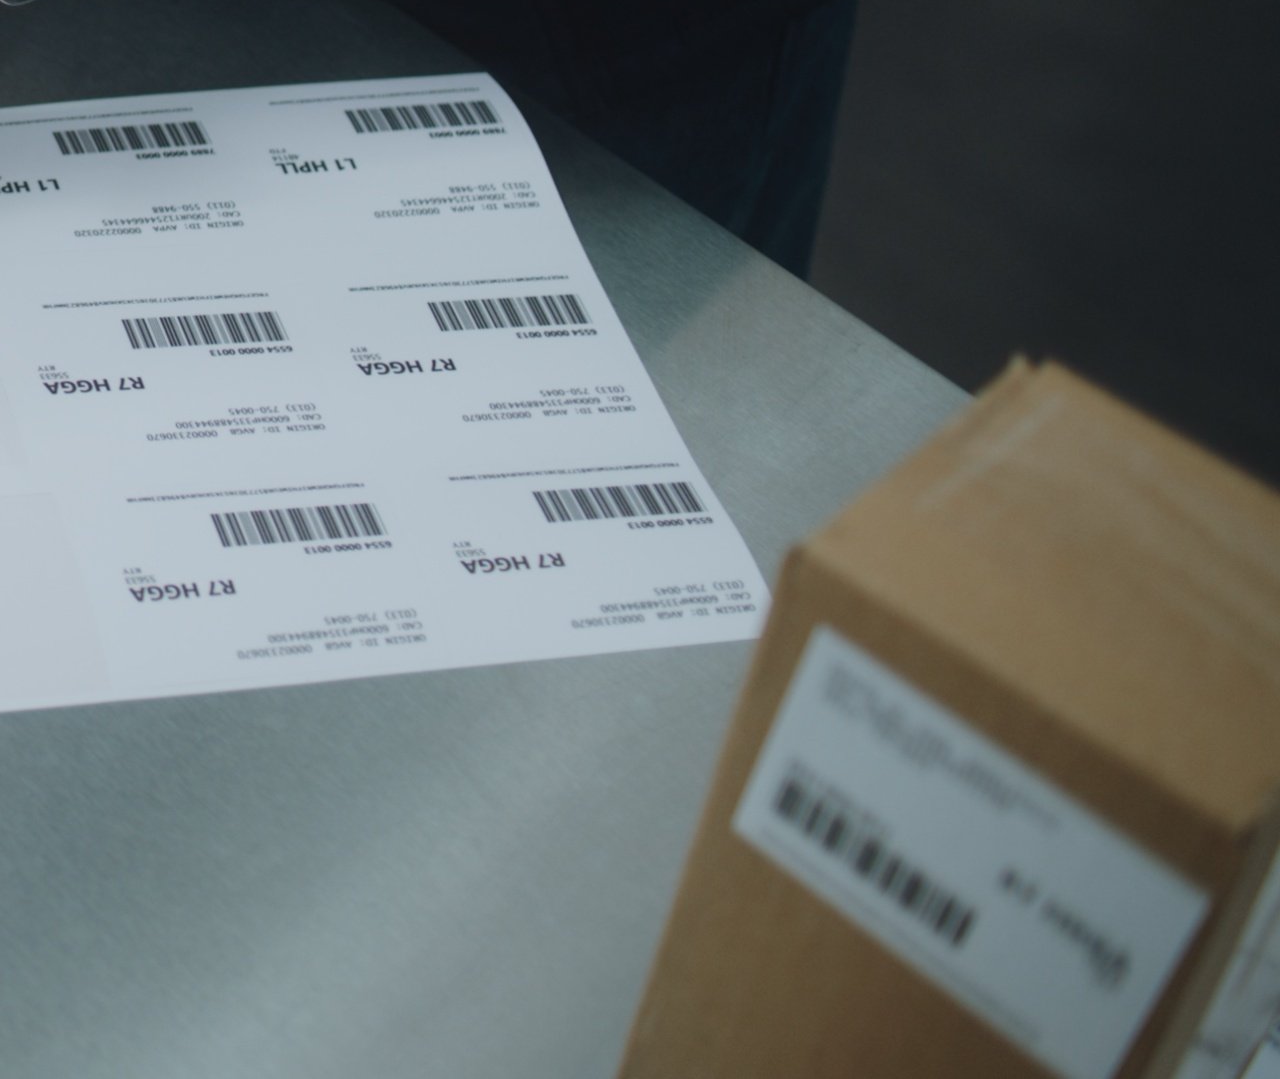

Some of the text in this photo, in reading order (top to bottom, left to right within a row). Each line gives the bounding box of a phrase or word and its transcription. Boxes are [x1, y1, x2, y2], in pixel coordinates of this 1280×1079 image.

[275, 157, 356, 174] L1 HPLL
[37, 178, 60, 191] L1
[501, 181, 530, 190] (011)
[206, 200, 236, 209] (011)
[206, 220, 244, 228] ORIGIN
[515, 328, 597, 339] 6554 0000 0013
[208, 348, 236, 356] 0013
[352, 353, 381, 361] 55633
[356, 358, 456, 375] R7 HGGA
[39, 371, 69, 380] 55633
[42, 376, 145, 394] R7 HGGA
[539, 384, 625, 397] (013) 750-0045
[607, 394, 631, 402] CAD:
[227, 402, 316, 415] (013) 750-0045
[262, 425, 280, 433] ID:
[286, 423, 325, 431] ORIGIN
[146, 429, 218, 441] 00002330670
[627, 516, 713, 529] 6554 0000 0013
[303, 540, 392, 554] 6554 0000 0013
[455, 548, 486, 558] 55633
[460, 552, 565, 574] R7 HGGA
[124, 575, 156, 584] 55633
[128, 579, 236, 602] R7 HGGA
[653, 579, 744, 596] (013) 750-0045
[726, 591, 751, 600] CAD:
[691, 607, 709, 616] ID:
[715, 603, 756, 613] ORIGIN
[323, 608, 417, 625] (013) 750-0045
[398, 621, 422, 630] CAD:
[360, 637, 378, 647] ID:
[384, 633, 426, 644] ORIGIN
